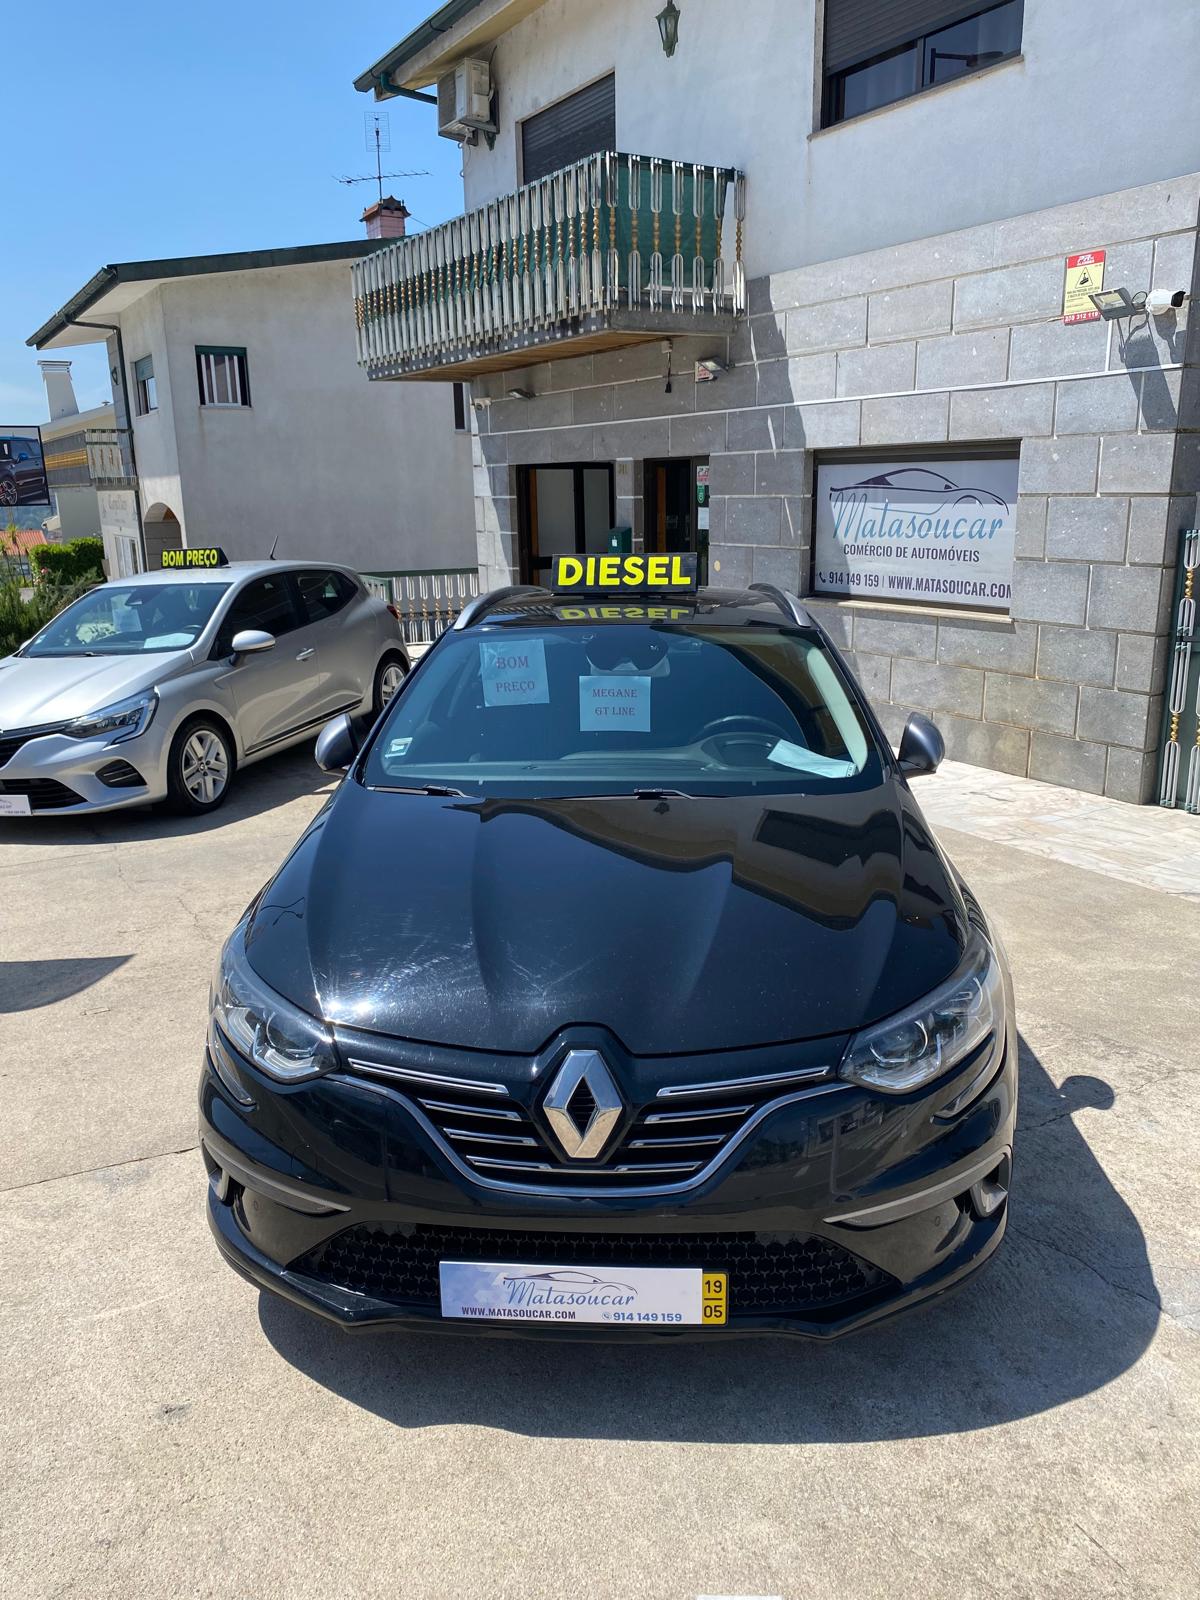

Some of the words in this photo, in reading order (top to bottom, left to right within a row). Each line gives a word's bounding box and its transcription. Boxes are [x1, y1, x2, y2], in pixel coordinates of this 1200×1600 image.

[832, 491, 1003, 543] Matasoucar
[162, 550, 184, 567] BOM
[186, 549, 218, 567] PREÇO
[843, 542, 892, 558] COMÉRCIO
[895, 547, 908, 558] DE
[911, 546, 980, 562] AUTOMÓVEIS
[557, 556, 691, 586] DIESEL
[829, 571, 844, 585] 914
[847, 573, 861, 586] 149
[864, 574, 879, 588] 159
[496, 655, 529, 670] BOM
[495, 680, 536, 694] PREÇO
[592, 688, 638, 698] MEGANE
[594, 706, 609, 717] GT
[612, 706, 635, 717] LINE
[505, 1279, 635, 1307] Matasoucar
[704, 1280, 722, 1294] 19
[461, 1306, 576, 1320] WWW.MATASOUCAR.COM
[613, 1311, 636, 1322] 914
[637, 1312, 659, 1322] 149
[661, 1312, 683, 1322] 159
[703, 1304, 723, 1319] 05
